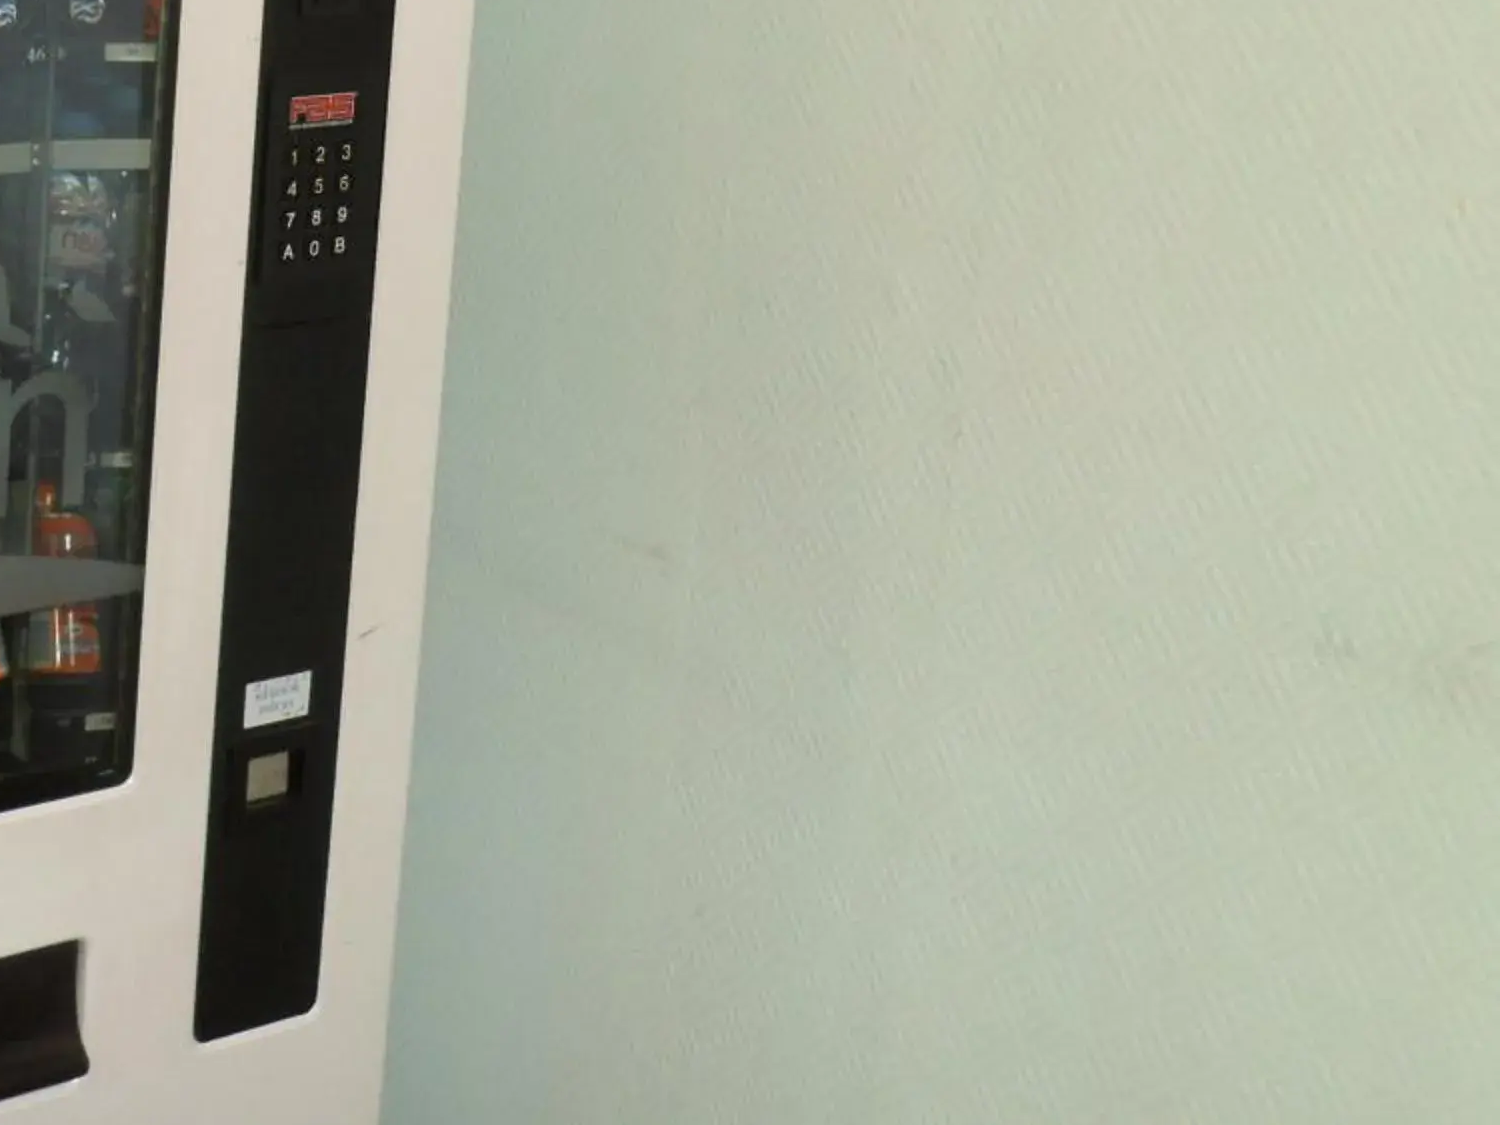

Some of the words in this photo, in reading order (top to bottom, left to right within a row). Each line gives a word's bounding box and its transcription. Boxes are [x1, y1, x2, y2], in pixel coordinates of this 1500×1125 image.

[291, 150, 298, 167] 1
[315, 146, 326, 163] 2
[341, 144, 352, 161] 3
[286, 180, 297, 197] 4
[314, 178, 324, 194] 5
[339, 174, 349, 191] 6
[285, 212, 296, 229] 7
[311, 209, 322, 226] 8
[337, 206, 348, 223] 9
[282, 243, 295, 261] A
